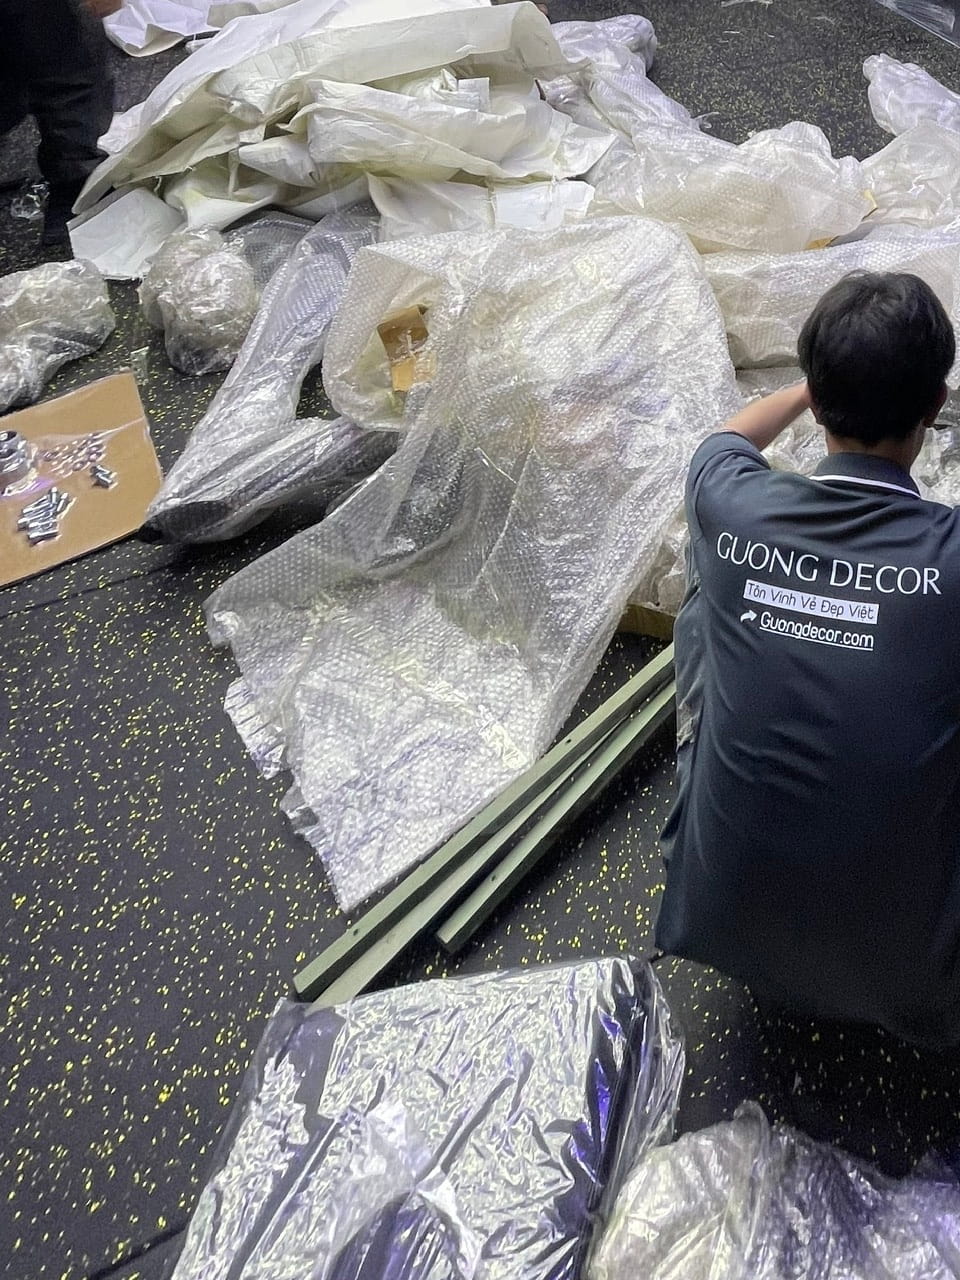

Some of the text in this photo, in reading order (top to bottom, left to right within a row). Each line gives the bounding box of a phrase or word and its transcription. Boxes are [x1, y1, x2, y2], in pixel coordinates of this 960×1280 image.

[717, 532, 942, 595] GUONG DECOR
[770, 589, 796, 607] Vinh
[820, 600, 844, 617] Đẹp
[848, 603, 874, 622] Việt
[760, 611, 874, 648] Guongdecor.com
